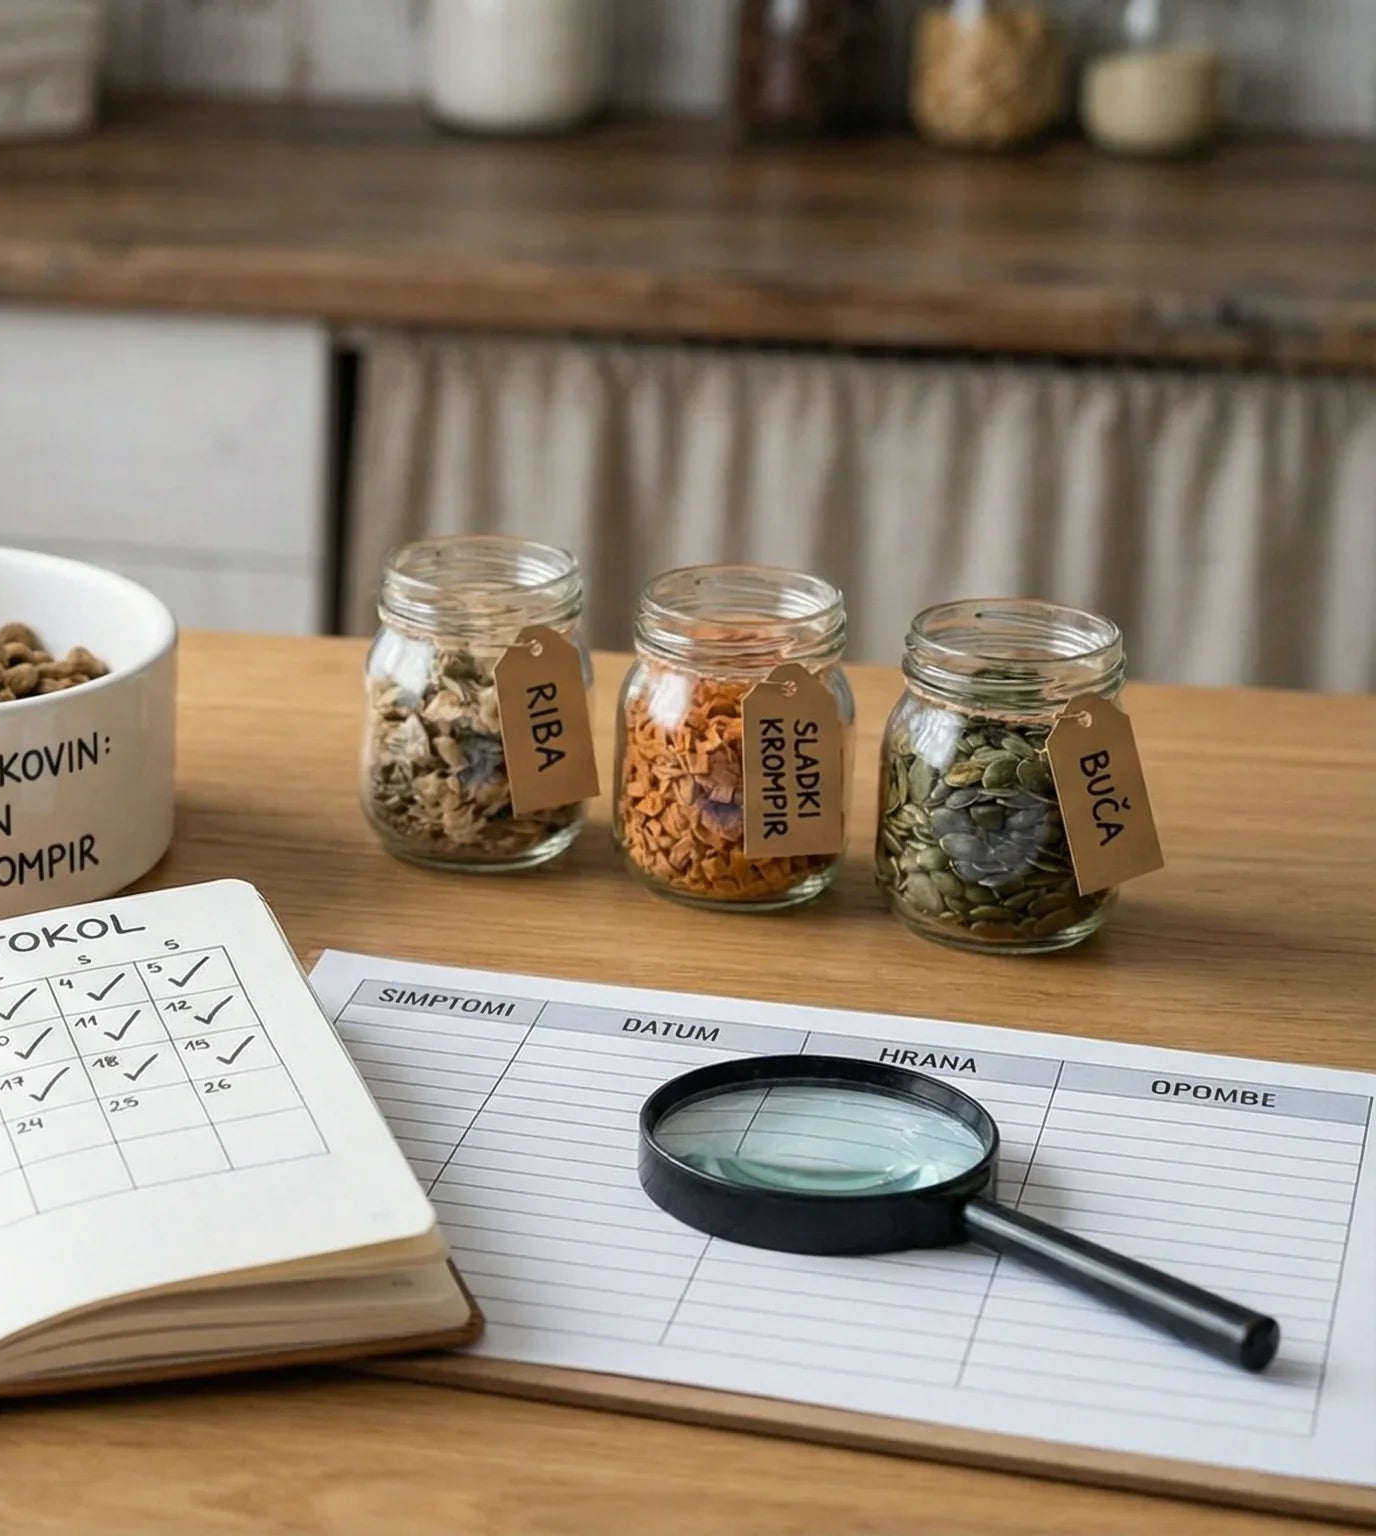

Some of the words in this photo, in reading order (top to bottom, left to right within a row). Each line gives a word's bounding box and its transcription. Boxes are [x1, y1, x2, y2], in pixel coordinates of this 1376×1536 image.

[526, 682, 566, 772] RIBA
[759, 718, 788, 839] KROMPIR
[793, 719, 821, 818] SLADKI
[1079, 750, 1131, 846] BUČA
[77, 955, 92, 965] S
[164, 939, 180, 950] S
[59, 978, 74, 990] 4
[146, 962, 163, 974] 5
[74, 1015, 98, 1029] 11
[164, 1000, 192, 1013] 12
[378, 988, 516, 1017] SIMPTOMI
[622, 1017, 720, 1042] DATUM
[0, 1076, 24, 1092] 17
[92, 1055, 119, 1068] 18
[879, 1047, 978, 1074] HRANA
[16, 1117, 44, 1135] 24
[109, 1095, 139, 1112] 25
[204, 1079, 232, 1094] 26
[1151, 1080, 1277, 1108] OPOMBE
